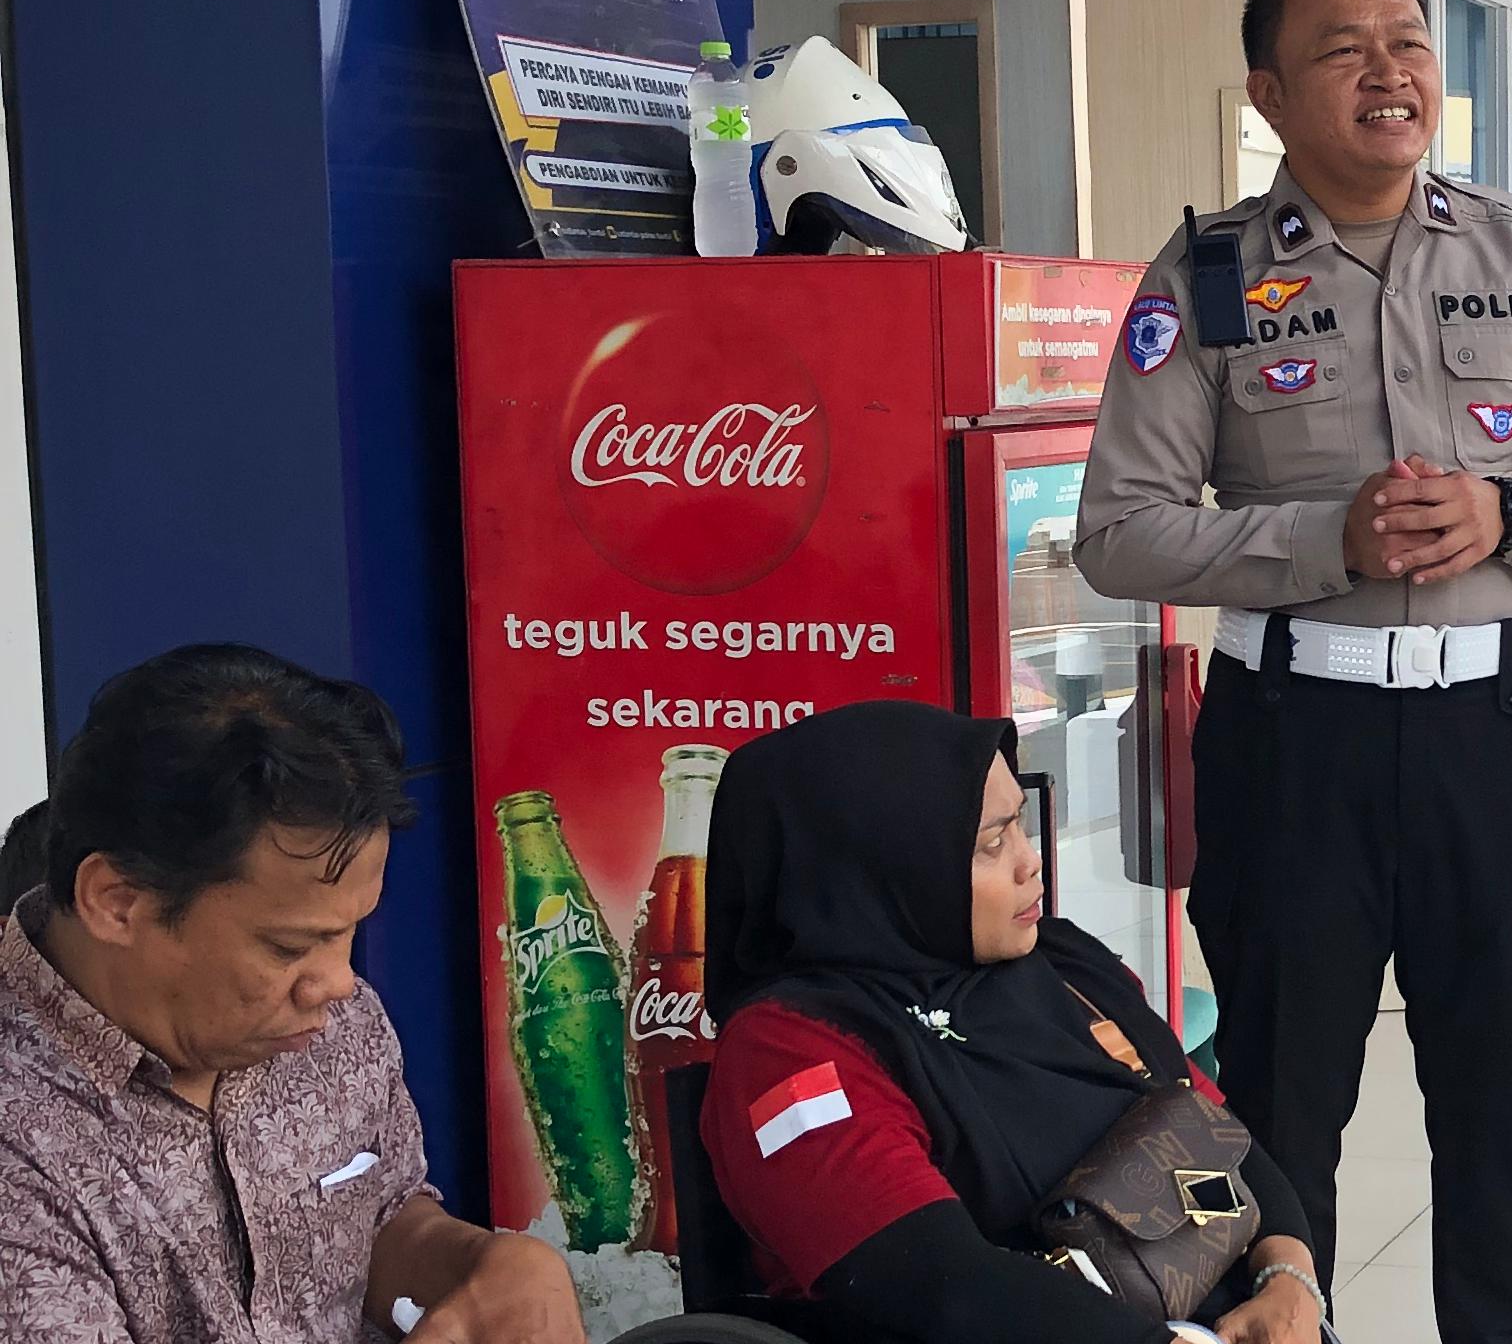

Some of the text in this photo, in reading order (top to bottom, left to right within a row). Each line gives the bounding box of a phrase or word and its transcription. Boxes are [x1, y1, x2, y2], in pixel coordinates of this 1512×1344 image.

[519, 58, 578, 85] PERCAYA
[579, 69, 631, 91] DENGAN
[537, 88, 565, 108] DIRI
[567, 92, 618, 114] SENDIRI
[618, 99, 640, 116] ITU
[640, 100, 677, 119] LEBIH
[538, 161, 620, 184] PENGABDIAN
[621, 168, 664, 188] UNTUK
[1001, 302, 1028, 323] Ambil
[1028, 302, 1072, 326] kesegaran
[1234, 307, 1338, 348] DAM
[1017, 337, 1044, 357] untuk
[570, 403, 818, 488] Coca-Cola
[1010, 476, 1039, 506] Sprite
[504, 612, 896, 660] teguk segarnya
[516, 910, 594, 986] Sprite
